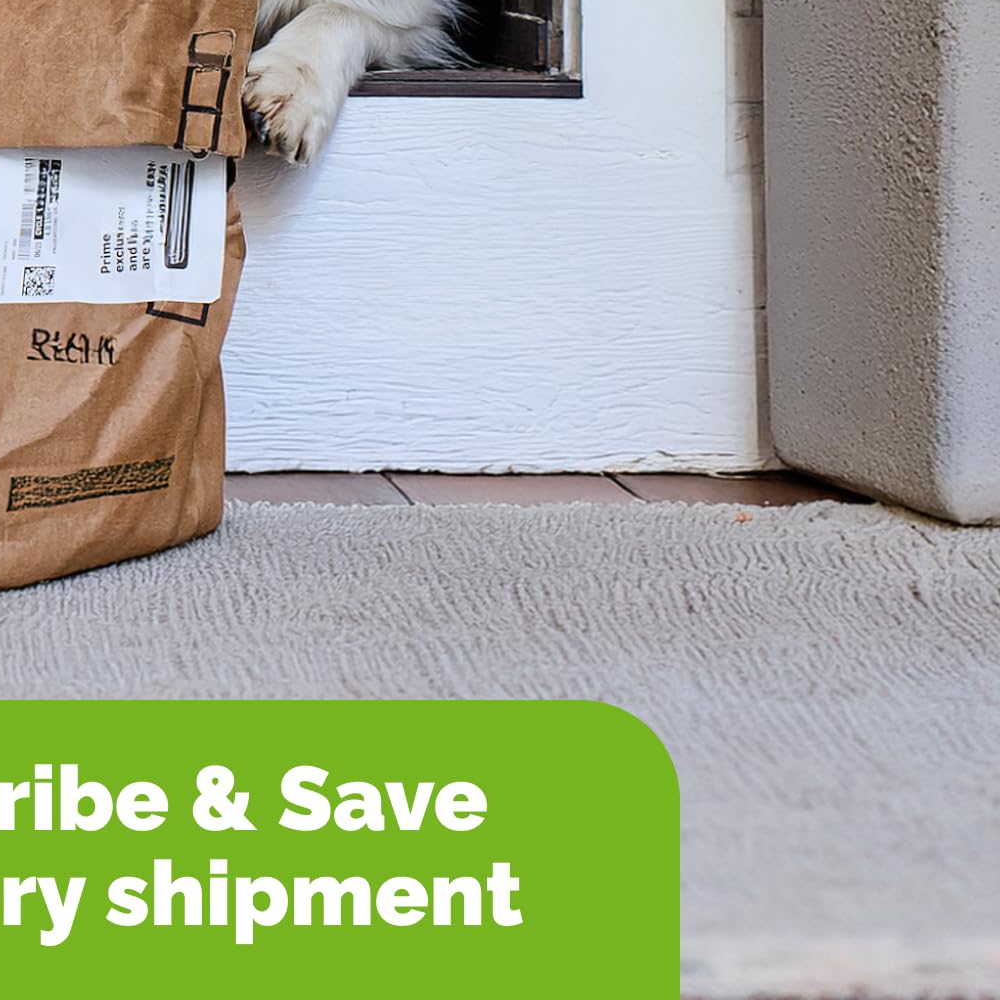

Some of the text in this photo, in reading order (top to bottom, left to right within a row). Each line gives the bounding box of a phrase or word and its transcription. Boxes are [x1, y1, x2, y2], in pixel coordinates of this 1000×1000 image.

[100, 233, 111, 274] Prime
[127, 247, 138, 272] and
[141, 247, 151, 270] are
